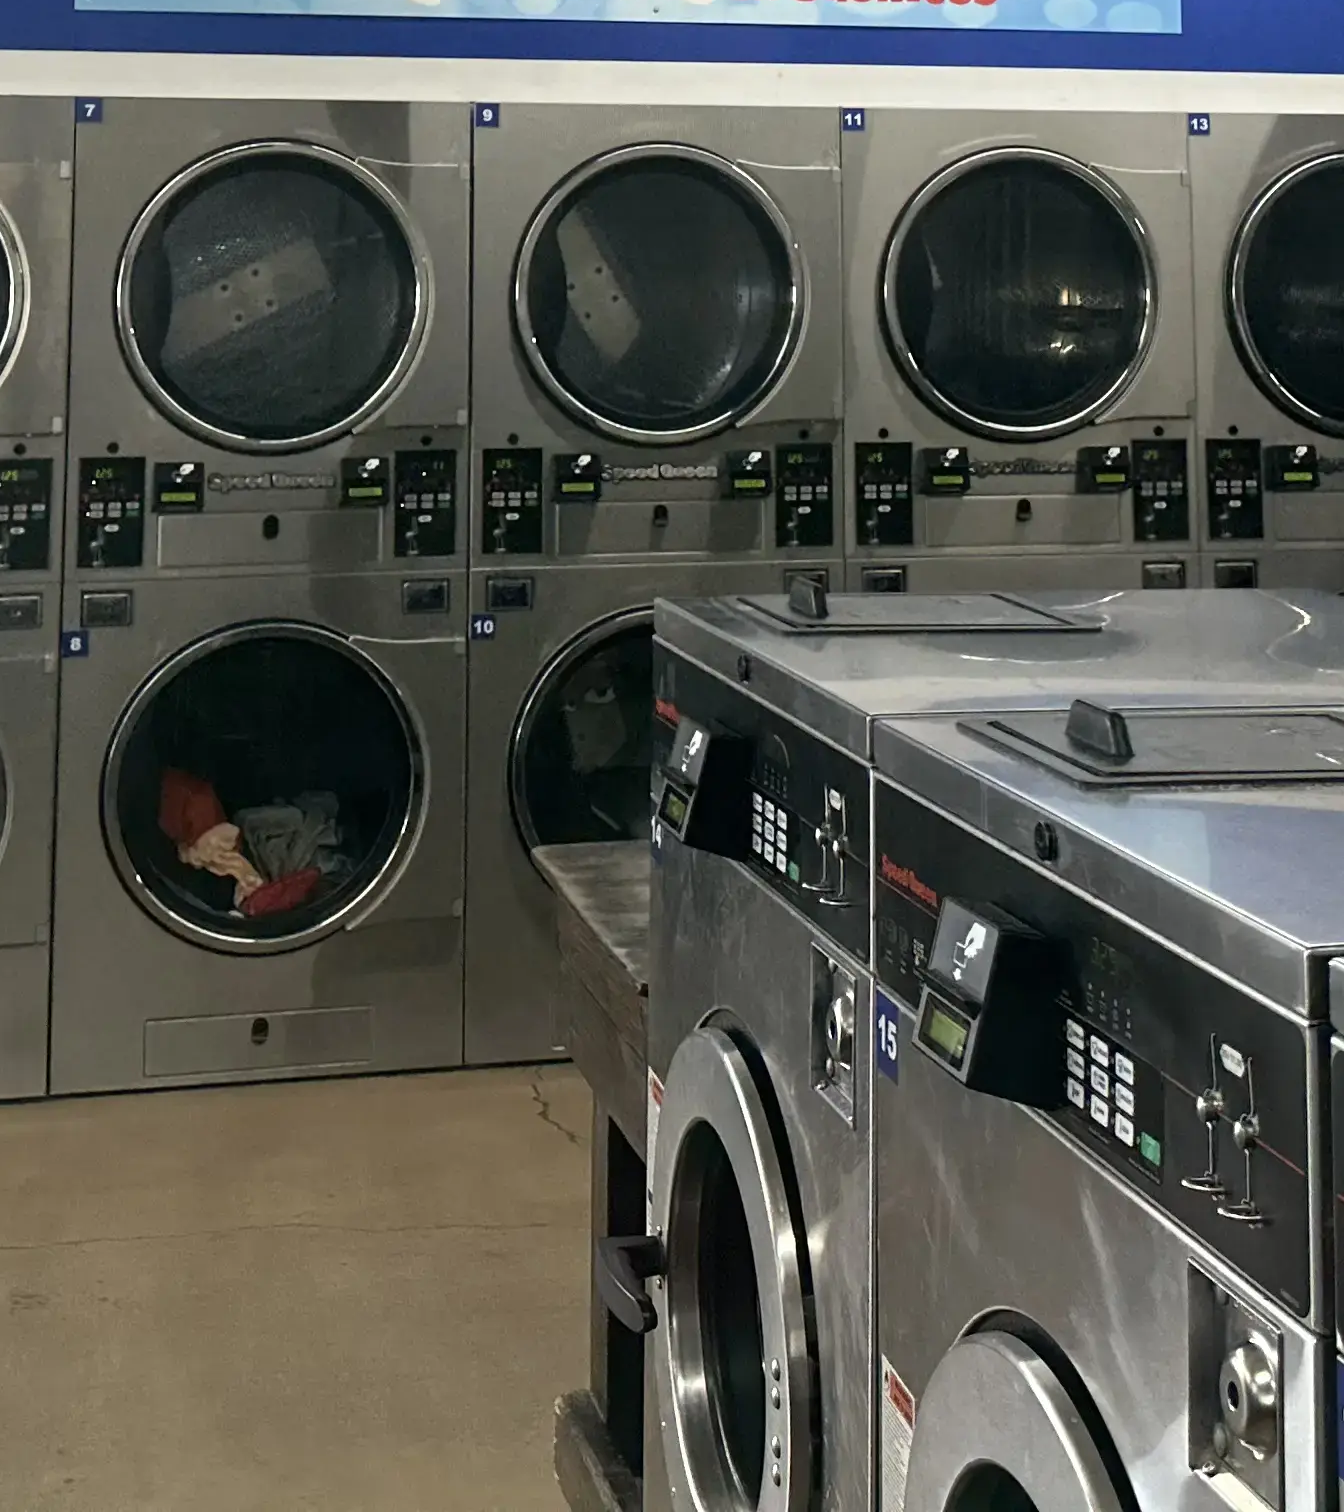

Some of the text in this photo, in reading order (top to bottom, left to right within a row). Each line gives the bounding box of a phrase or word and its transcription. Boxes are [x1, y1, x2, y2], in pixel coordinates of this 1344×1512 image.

[84, 104, 96, 117] 7
[482, 109, 493, 122] 9
[844, 114, 861, 126] 11
[1190, 118, 1208, 130] 13
[474, 620, 493, 634] 10
[70, 637, 81, 651] 8
[878, 1014, 897, 1061] 15
